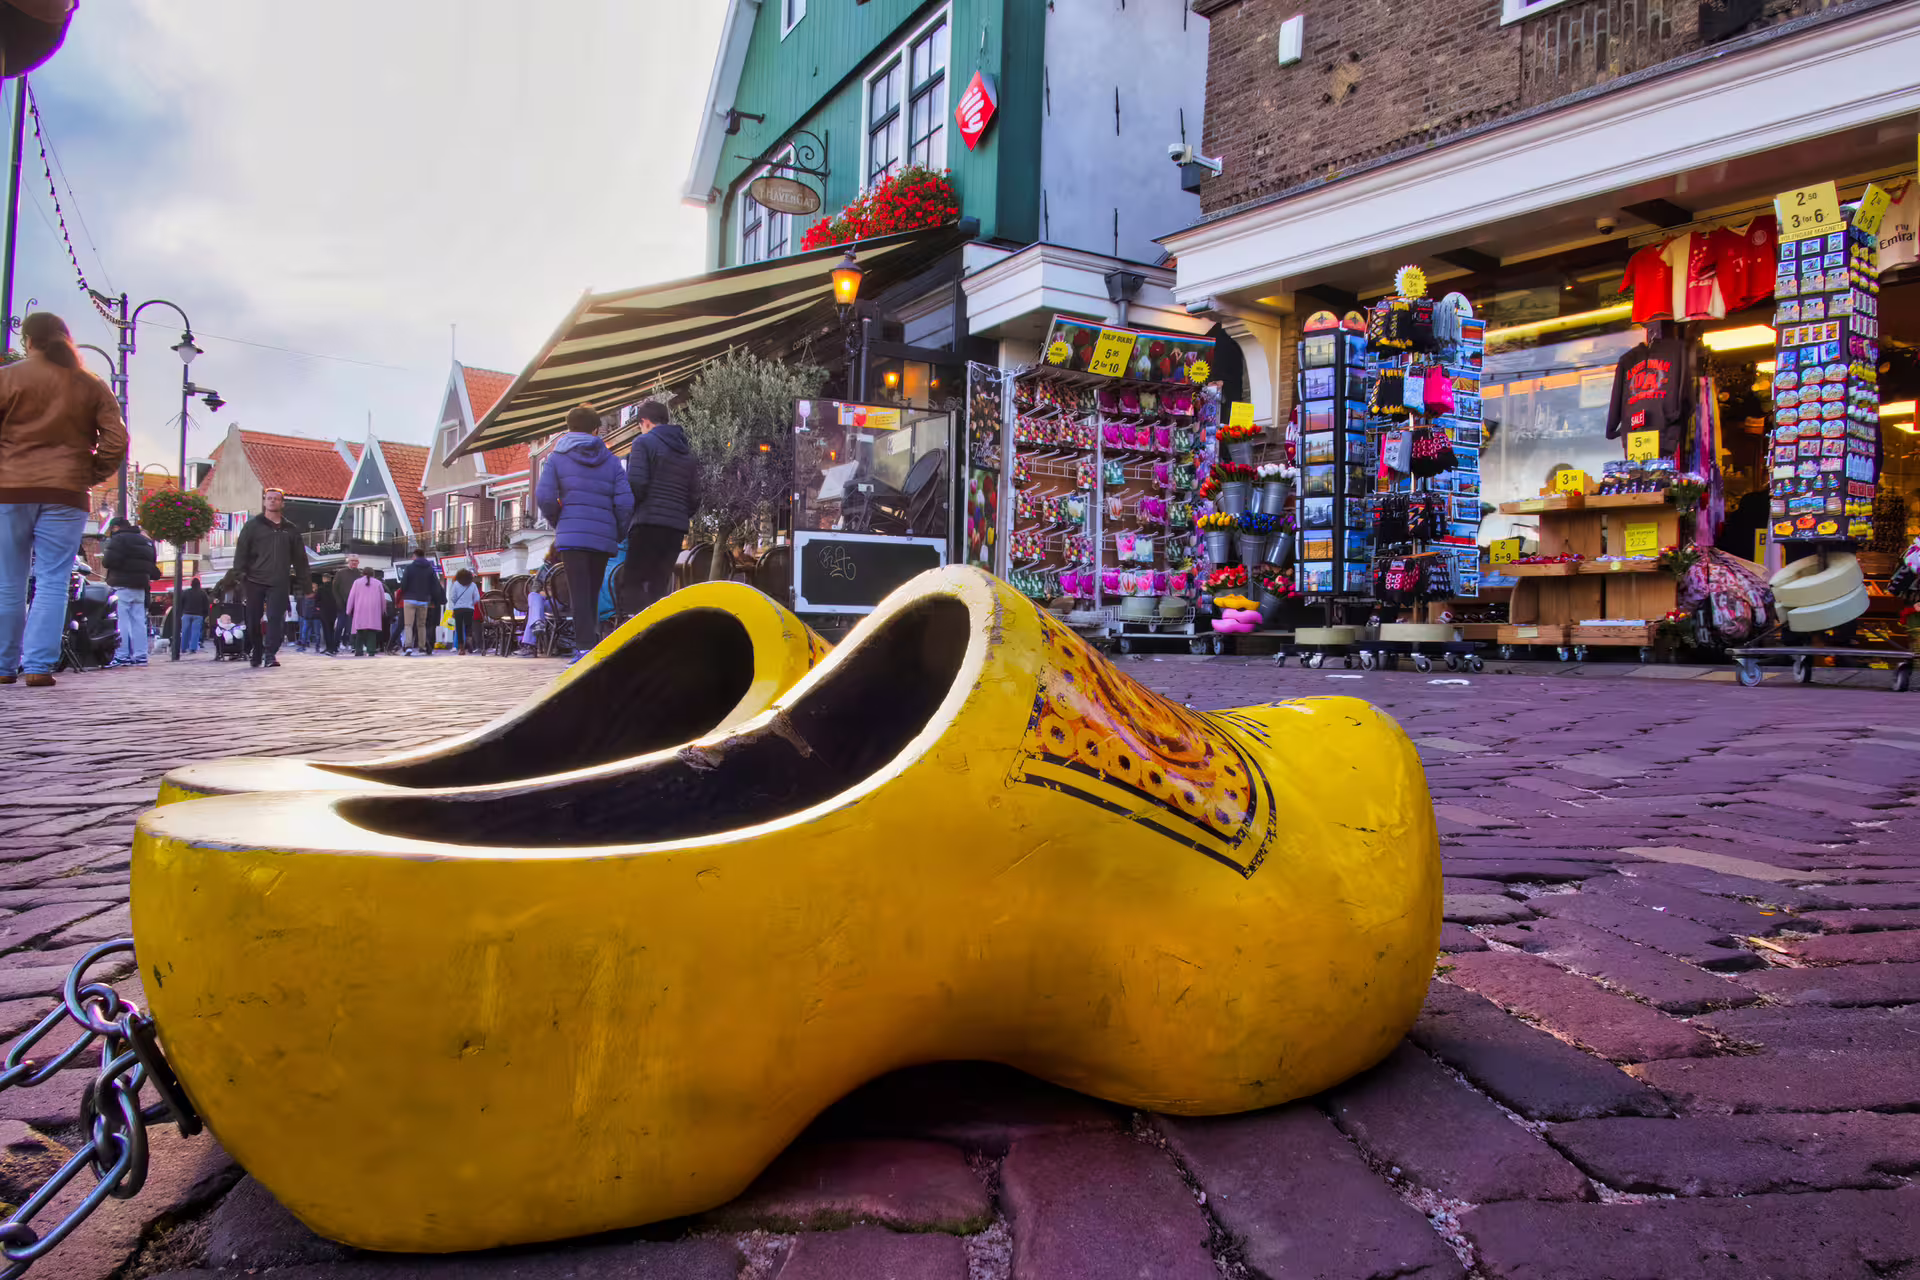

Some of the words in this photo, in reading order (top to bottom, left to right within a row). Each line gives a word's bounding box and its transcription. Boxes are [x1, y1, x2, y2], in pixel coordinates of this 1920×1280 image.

[960, 87, 984, 133] illy
[1791, 214, 1801, 228] 3
[1814, 224, 1845, 234] MAGNETS
[1102, 333, 1117, 341] TULIP
[1117, 335, 1134, 345] BULBS
[1093, 360, 1100, 370] 2
[1109, 363, 1119, 373] 10
[1631, 412, 1645, 426] SALE
